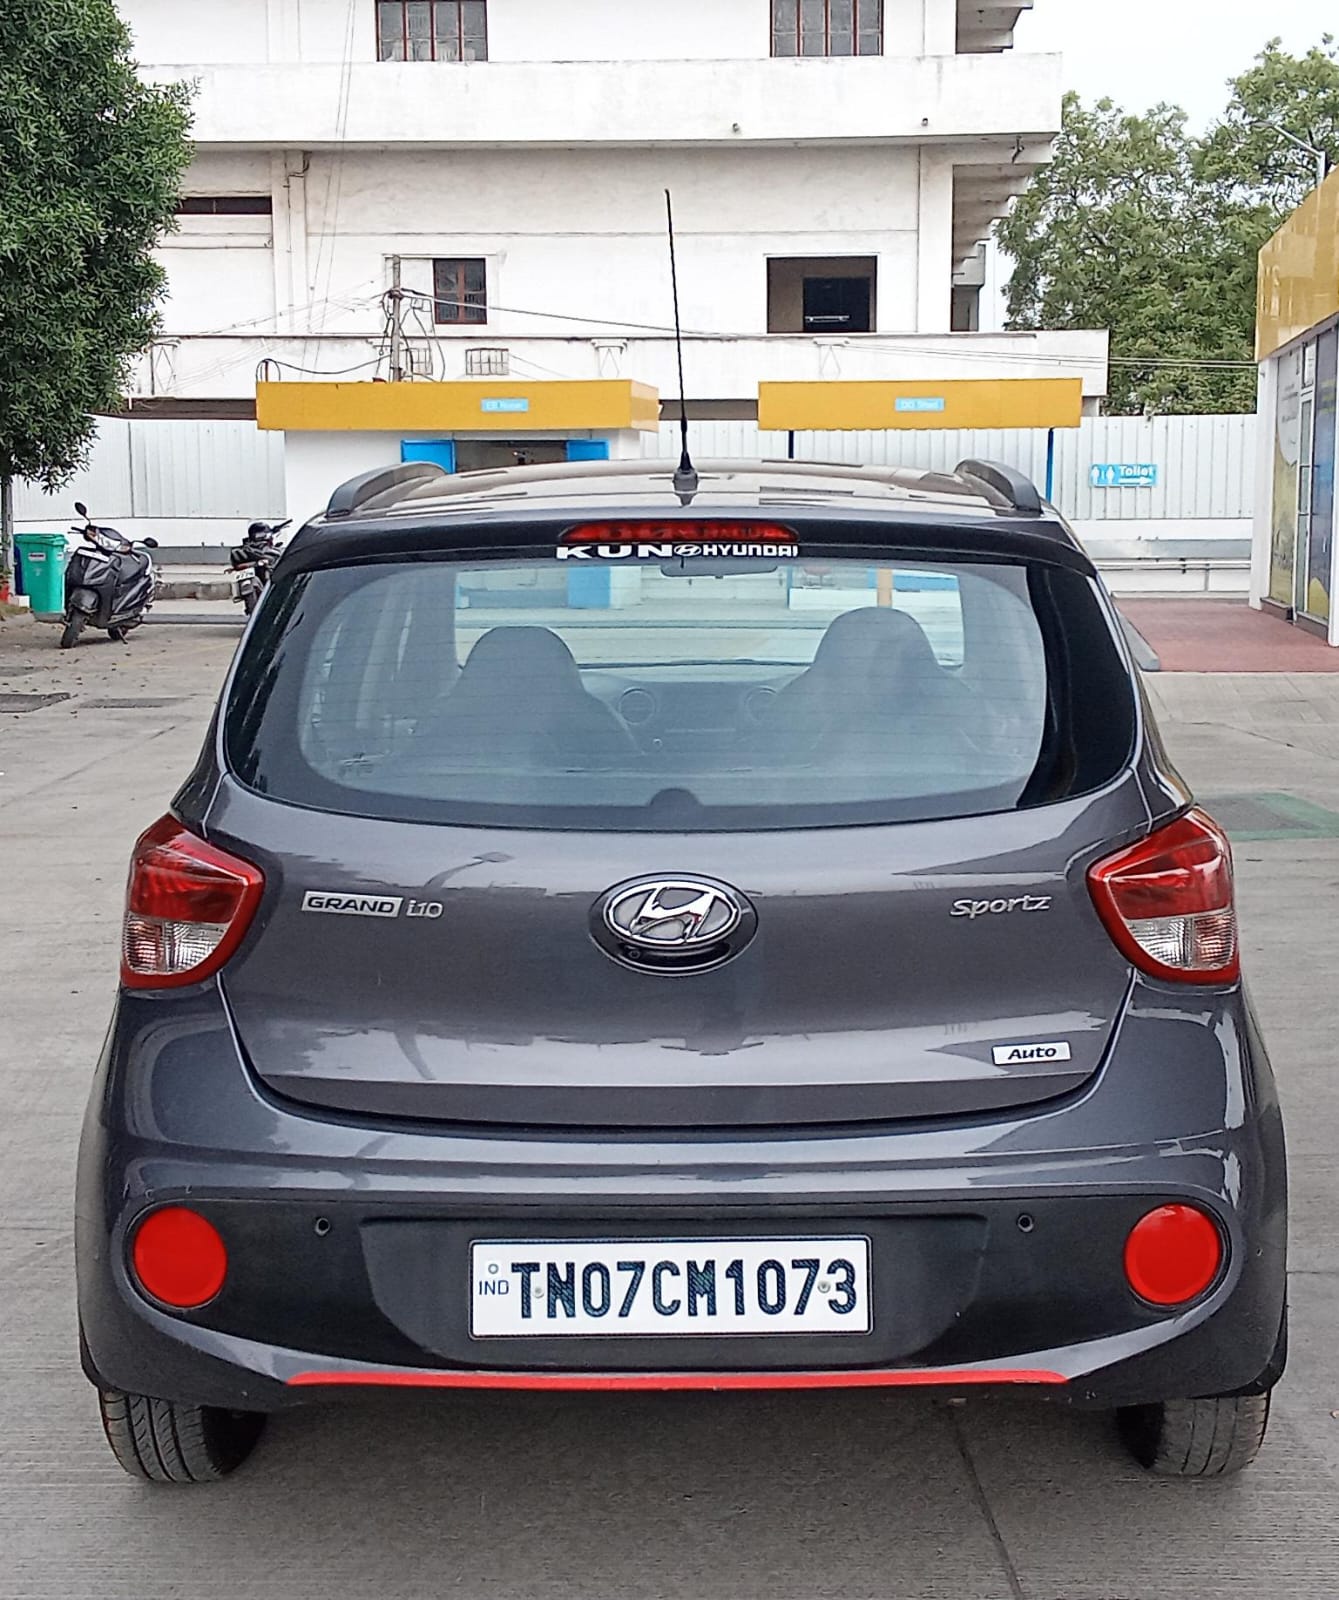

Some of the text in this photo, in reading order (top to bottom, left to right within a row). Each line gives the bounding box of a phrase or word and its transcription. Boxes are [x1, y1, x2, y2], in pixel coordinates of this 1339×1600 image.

[1119, 465, 1153, 477] Toilet
[556, 544, 799, 559] KUN HYUNDAI
[307, 896, 443, 918] GRAND i10
[950, 895, 1052, 919] Sportz
[1007, 1046, 1057, 1060] Auto
[478, 1258, 857, 1319] IND TN07CM1073
